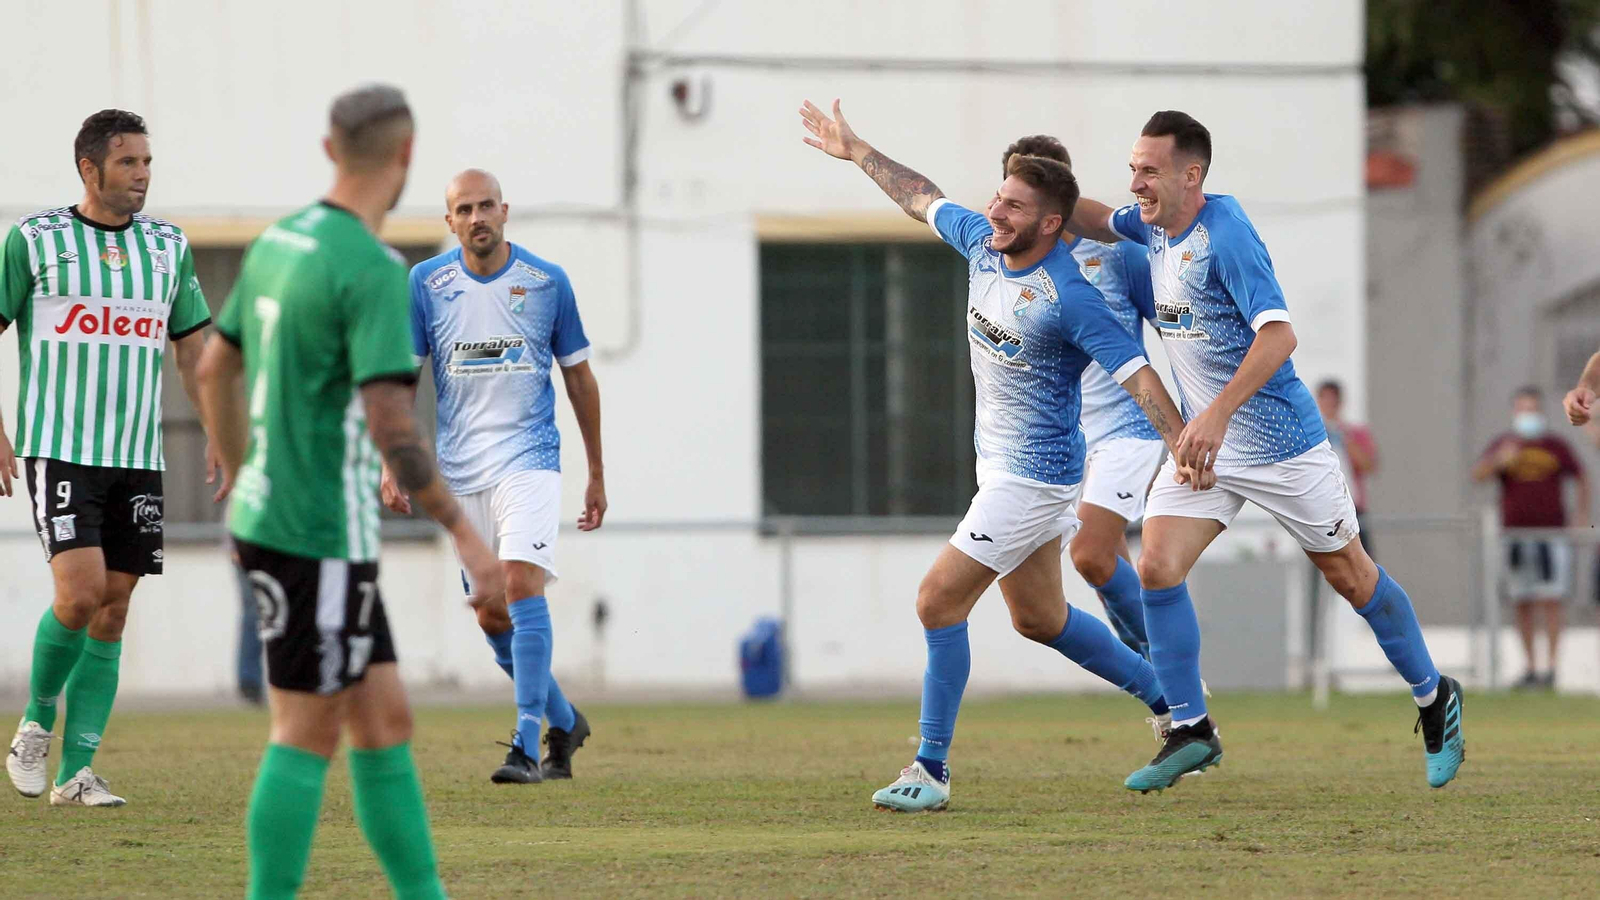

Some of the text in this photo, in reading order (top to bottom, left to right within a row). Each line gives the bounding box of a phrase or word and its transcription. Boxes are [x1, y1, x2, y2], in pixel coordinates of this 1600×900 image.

[431, 269, 457, 289] LUGO
[55, 303, 163, 340] Solear
[969, 304, 1022, 346] Torralva
[453, 339, 523, 352] Torralva
[56, 480, 72, 509] 9
